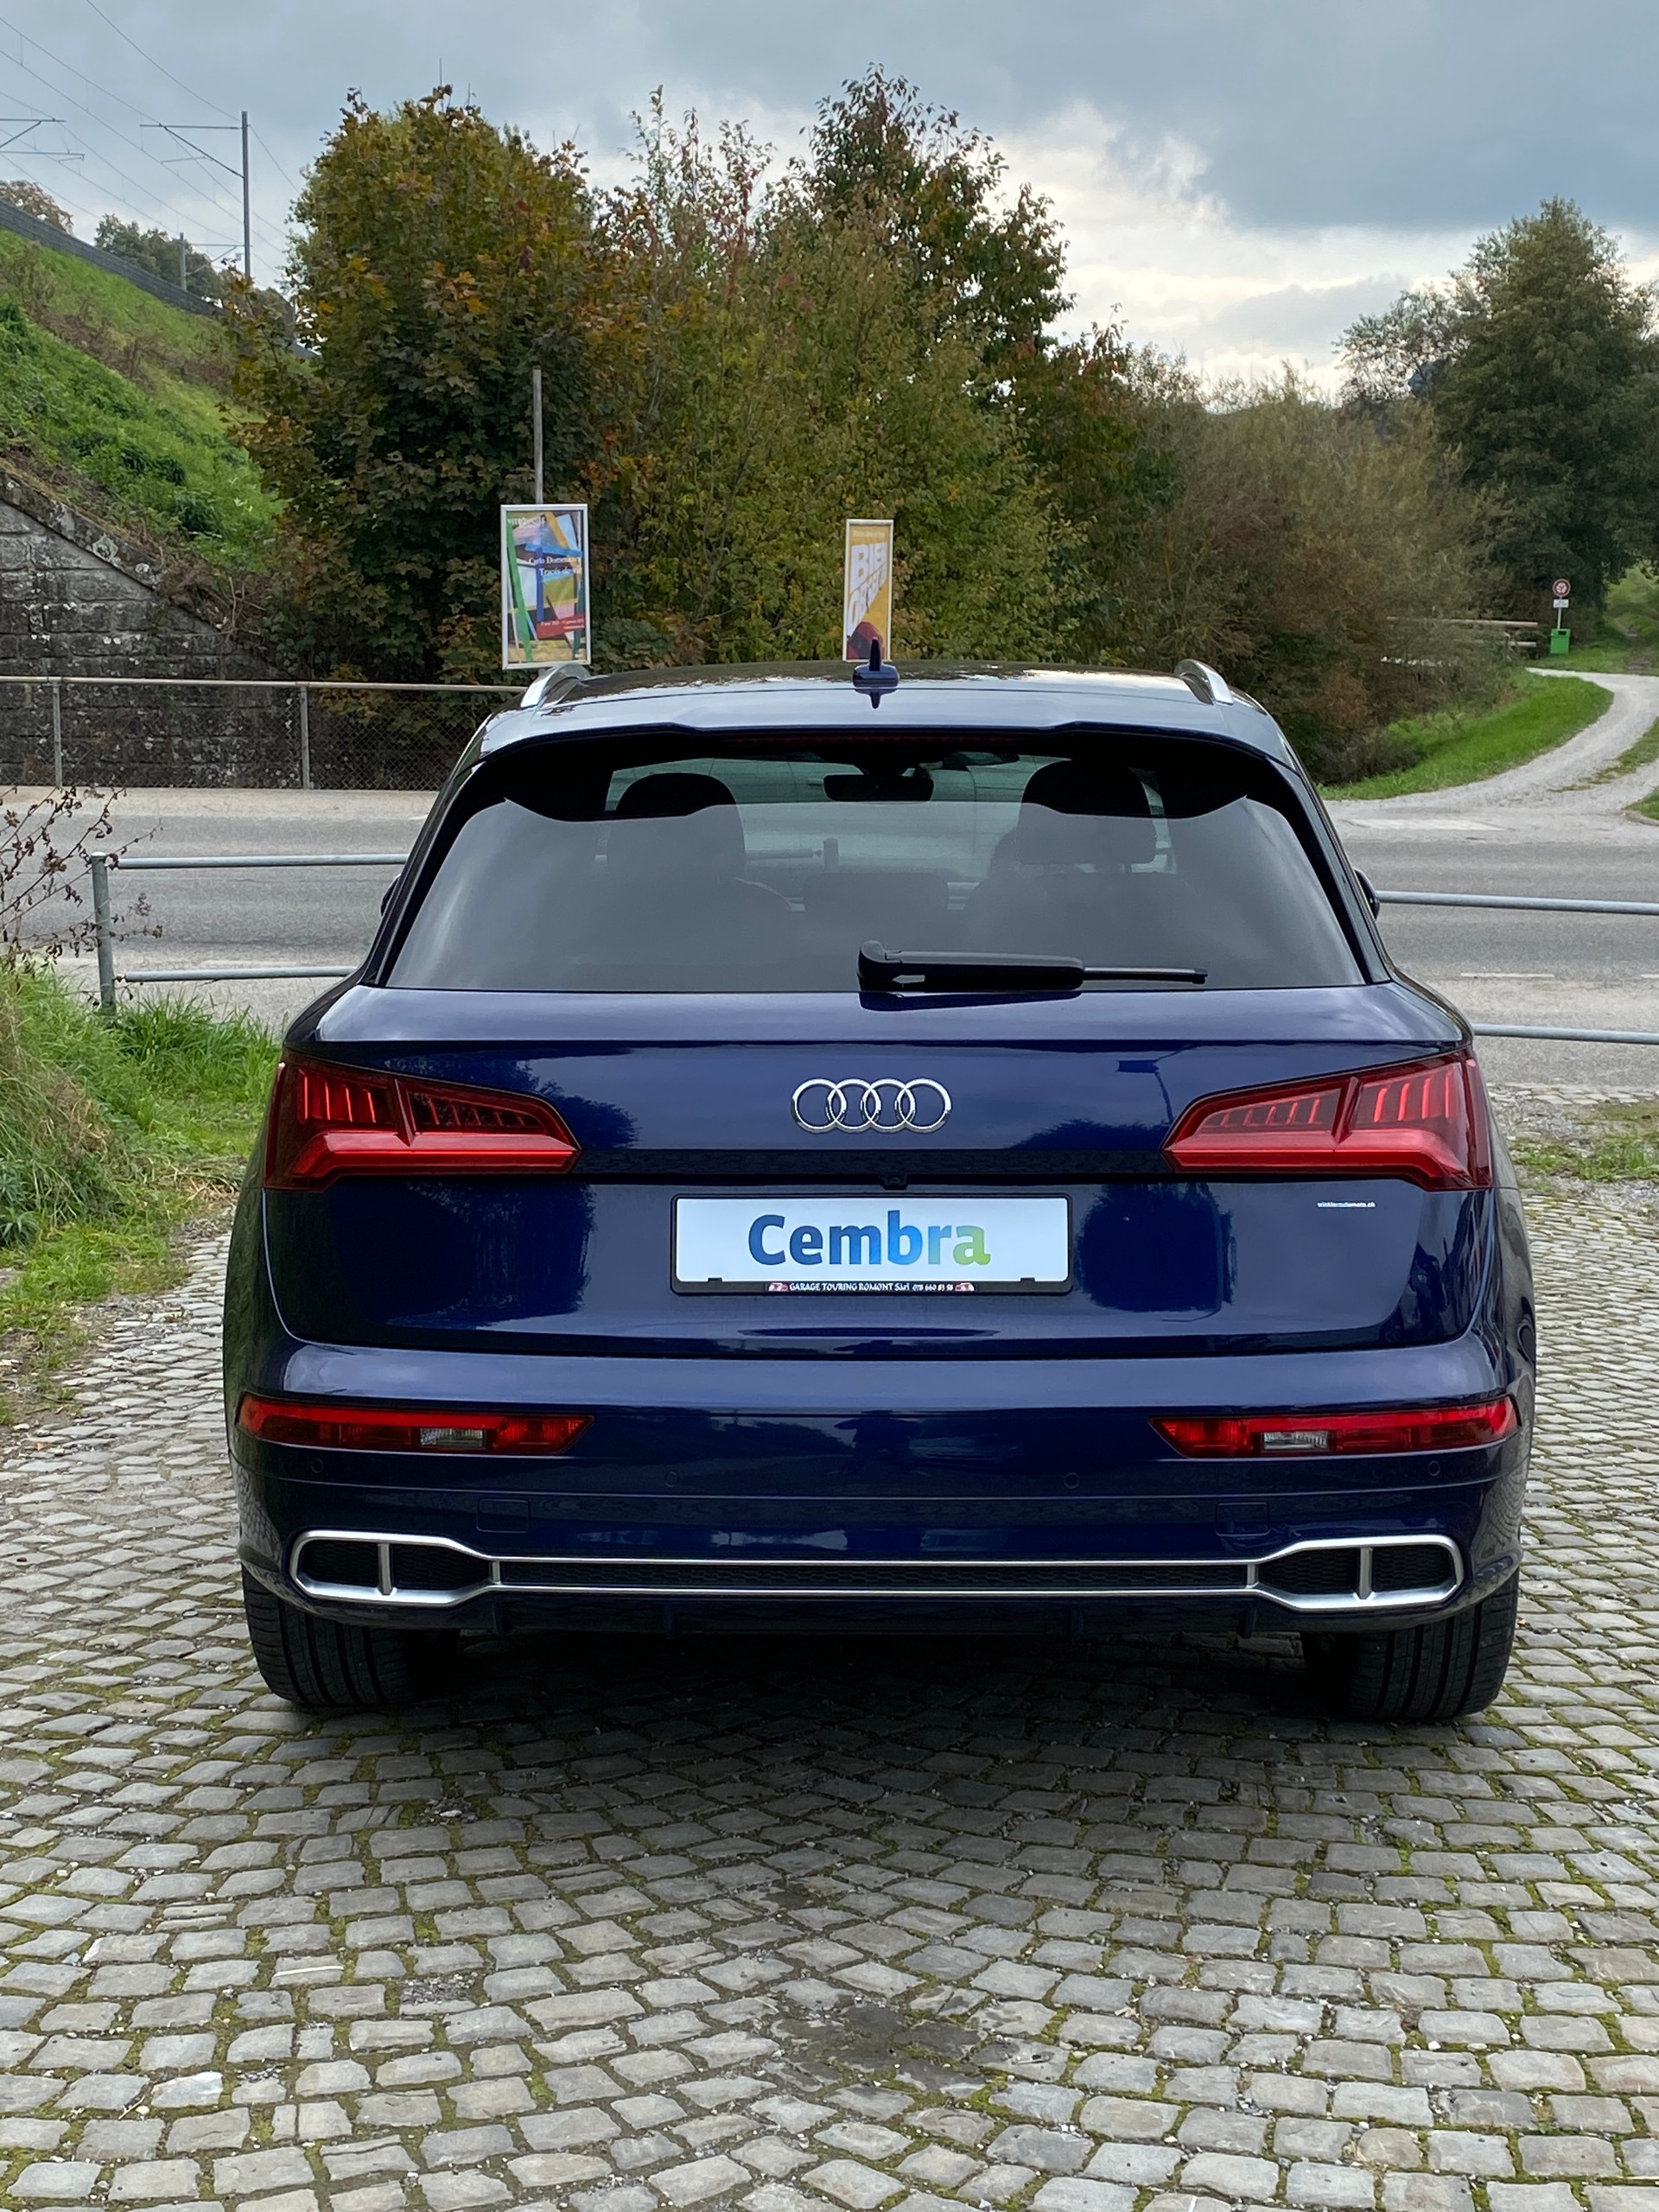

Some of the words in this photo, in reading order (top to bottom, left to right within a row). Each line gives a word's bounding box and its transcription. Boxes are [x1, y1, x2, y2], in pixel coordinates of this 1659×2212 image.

[748, 1210, 991, 1266] Cembra
[790, 1282, 821, 1292] GARAGE
[822, 1282, 857, 1292] TOURING
[858, 1282, 893, 1292] ROMONT
